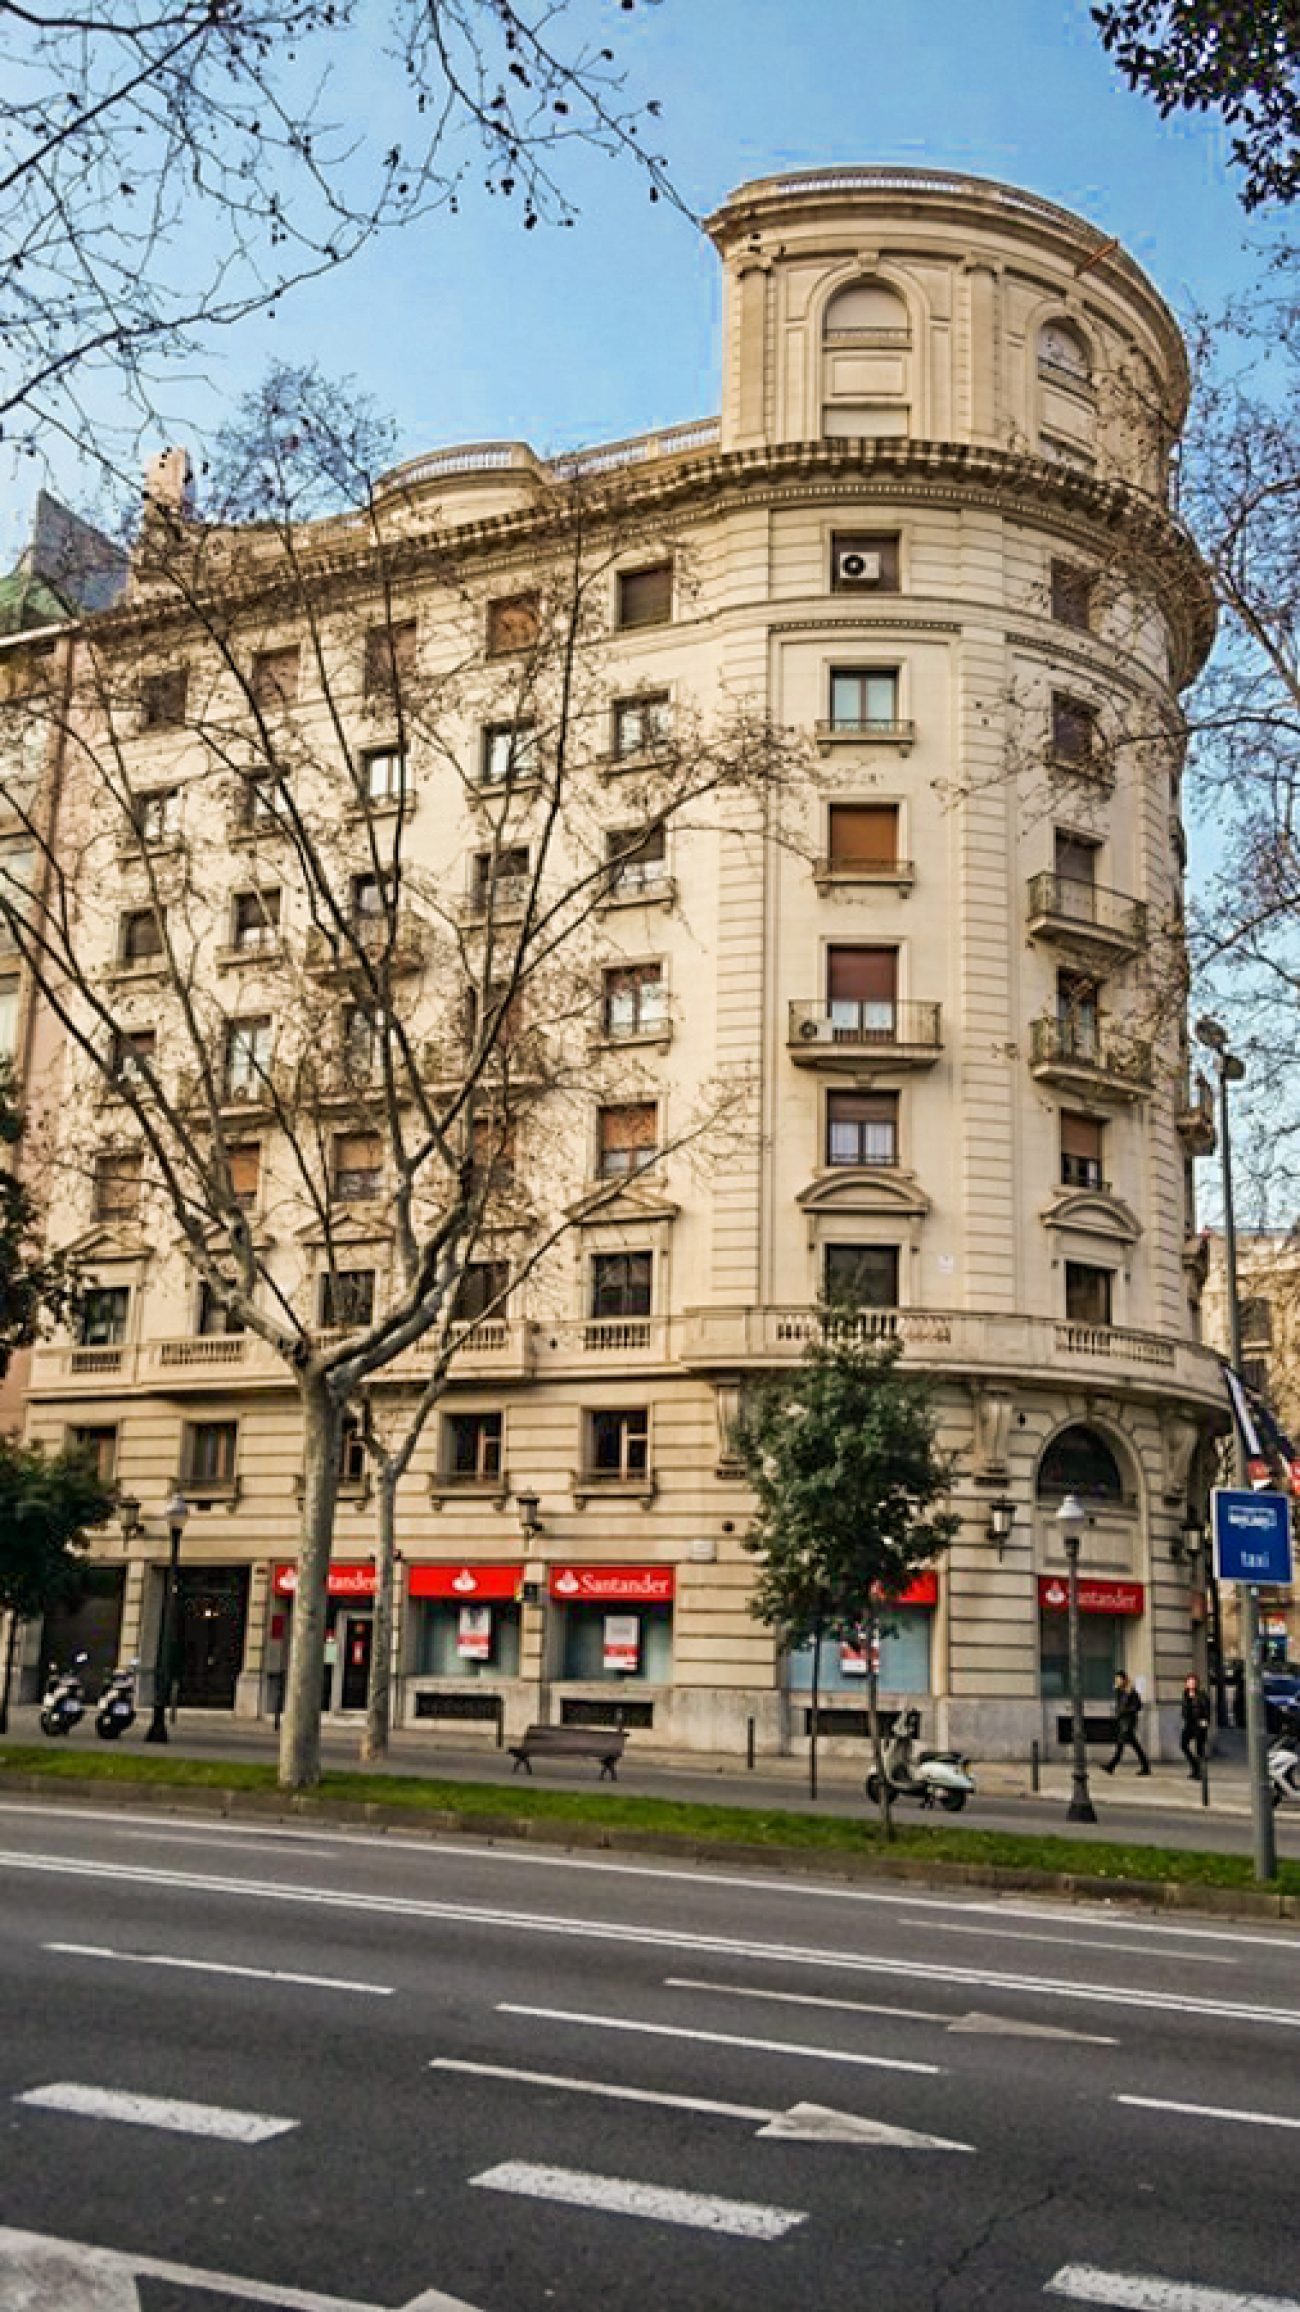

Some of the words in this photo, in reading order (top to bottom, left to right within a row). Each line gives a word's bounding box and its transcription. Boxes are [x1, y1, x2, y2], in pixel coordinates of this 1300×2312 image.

[1241, 1551, 1269, 1568] taxi
[328, 1570, 377, 1590] tander
[581, 1572, 669, 1593] Santander
